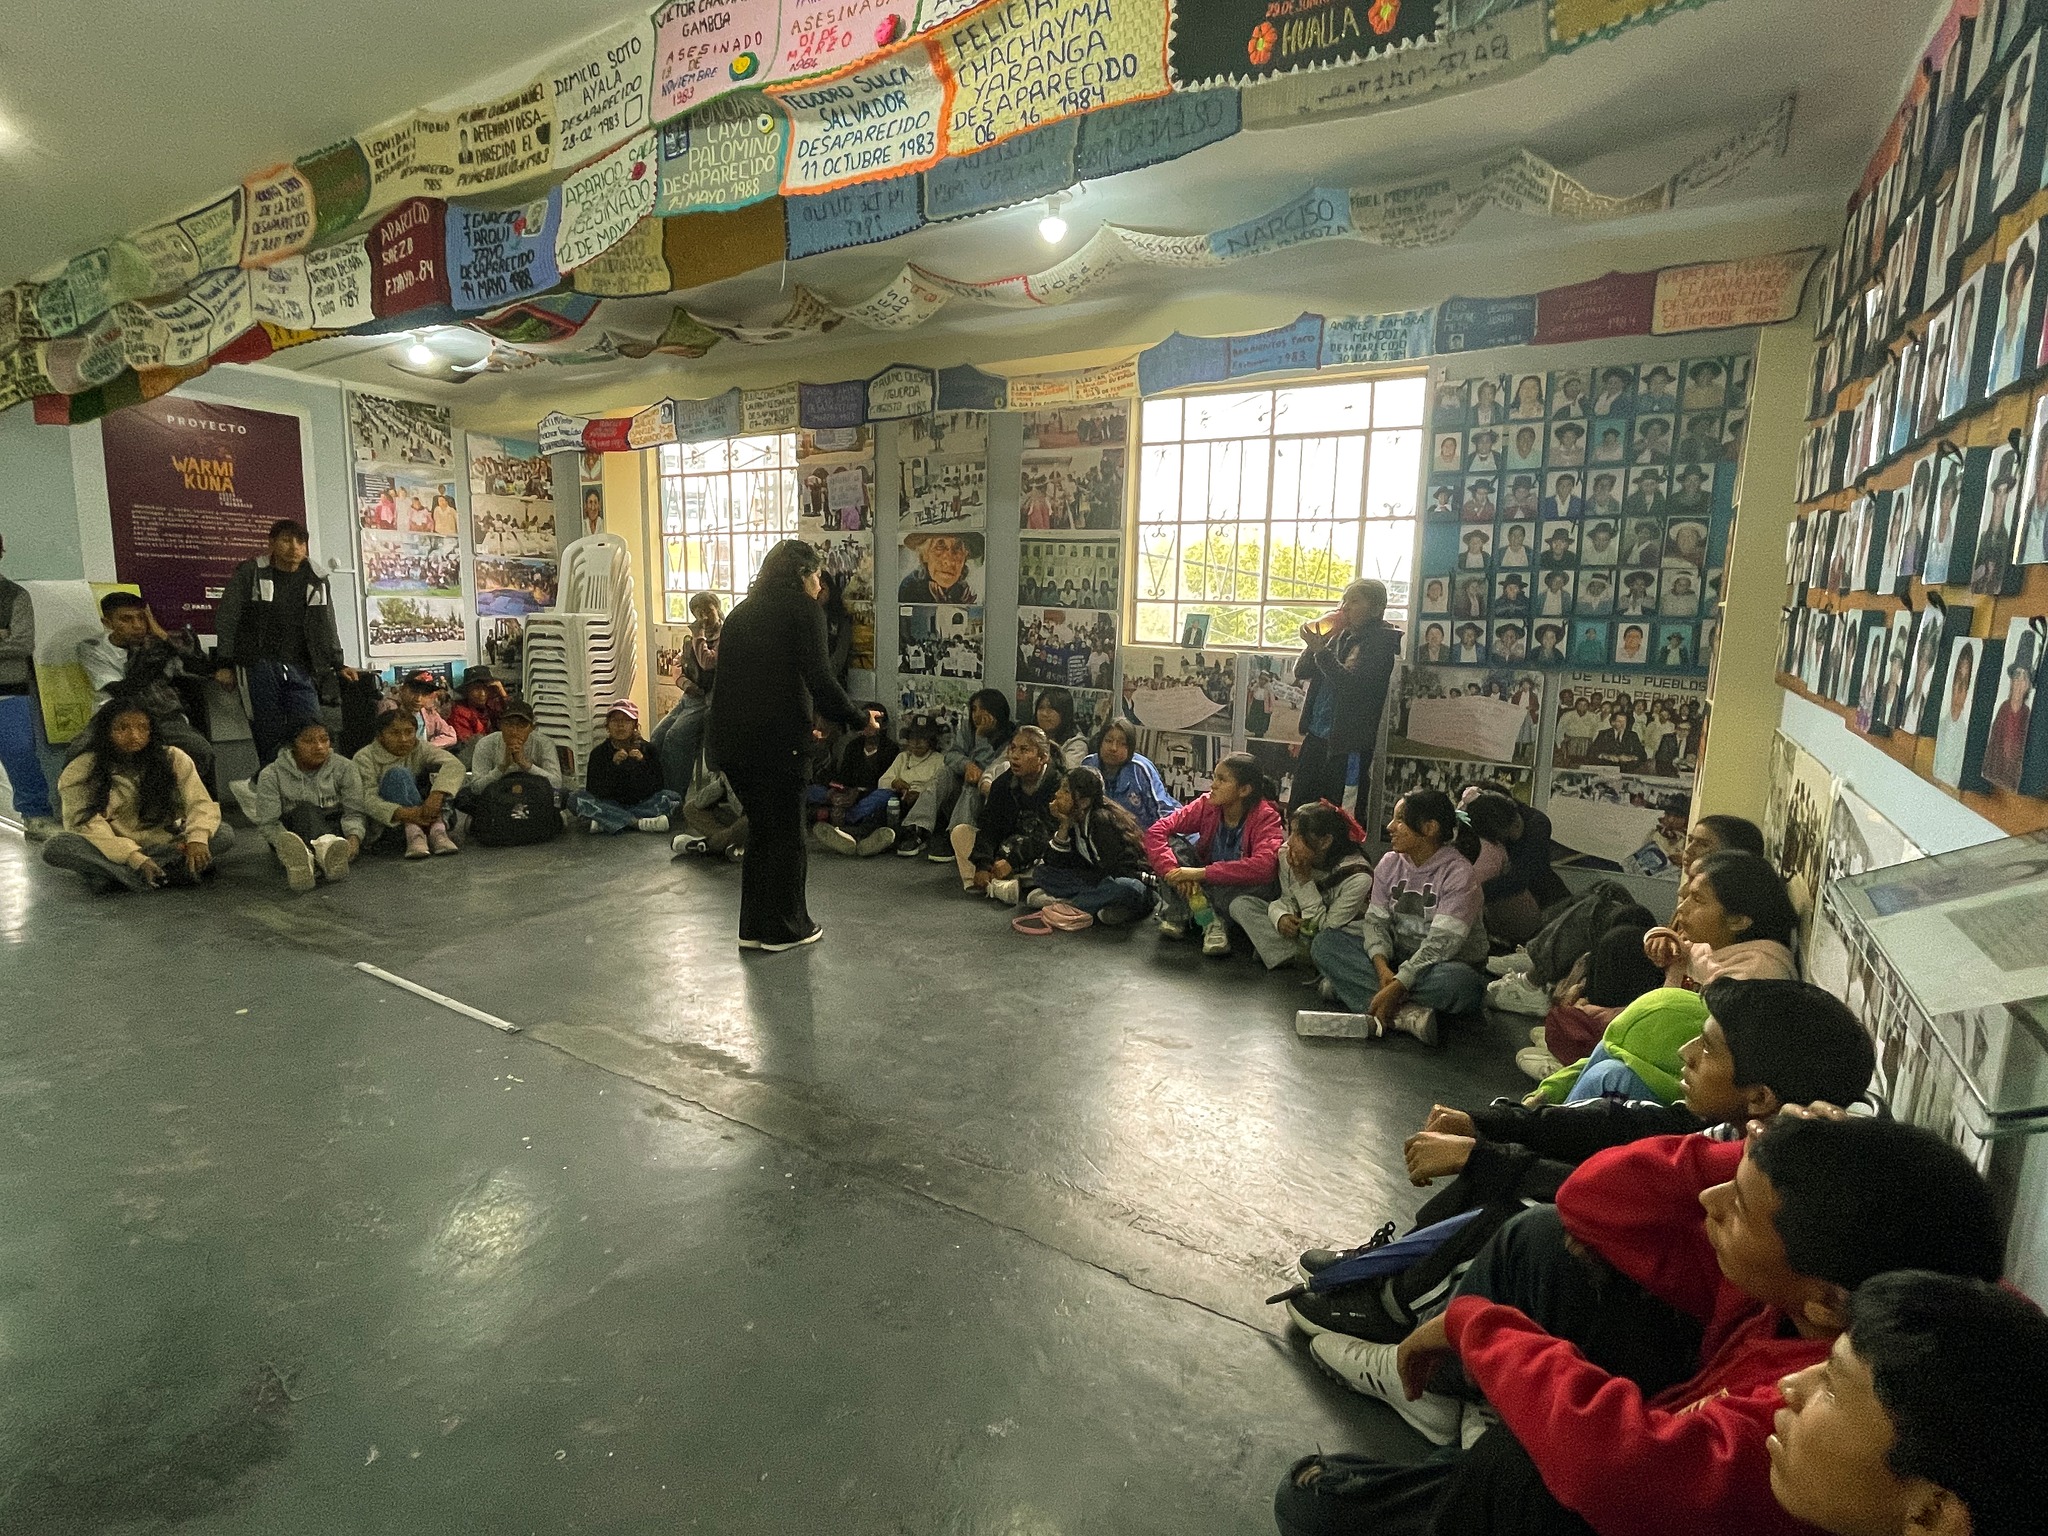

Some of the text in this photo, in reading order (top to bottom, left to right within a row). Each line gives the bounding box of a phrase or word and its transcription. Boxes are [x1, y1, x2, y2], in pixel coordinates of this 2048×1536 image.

[682, 12, 731, 37] GAMBOA
[1282, 6, 1359, 56] HUALLA
[607, 37, 641, 69] SOTO
[666, 31, 762, 65] ASESINADO
[787, 31, 852, 61] MARZO
[662, 66, 718, 97] NOVIEMBRE
[974, 30, 1107, 104] YARANGA
[582, 69, 622, 105] AYALA
[779, 67, 914, 110] TEODORO SULCA
[954, 53, 1137, 131] DESAPARECIDO
[820, 90, 909, 132] SALVADOR
[798, 111, 930, 158] DESAPARECIDO
[688, 132, 781, 171] PALOMINO
[801, 132, 934, 181] 11 OCTUBRE 1983
[662, 155, 776, 196] DESAPARECIDO
[686, 188, 726, 206] MAYO
[730, 178, 760, 200] 1988
[1227, 198, 1334, 253] NARCISO
[574, 237, 594, 259] DE
[477, 276, 506, 300] MAYO
[1353, 328, 1408, 342] MENDOZA
[166, 414, 247, 434] PROYECTO
[172, 455, 234, 477] WARMI
[184, 473, 235, 493] KUNA
[1644, 676, 1706, 691] PUEBLOS
